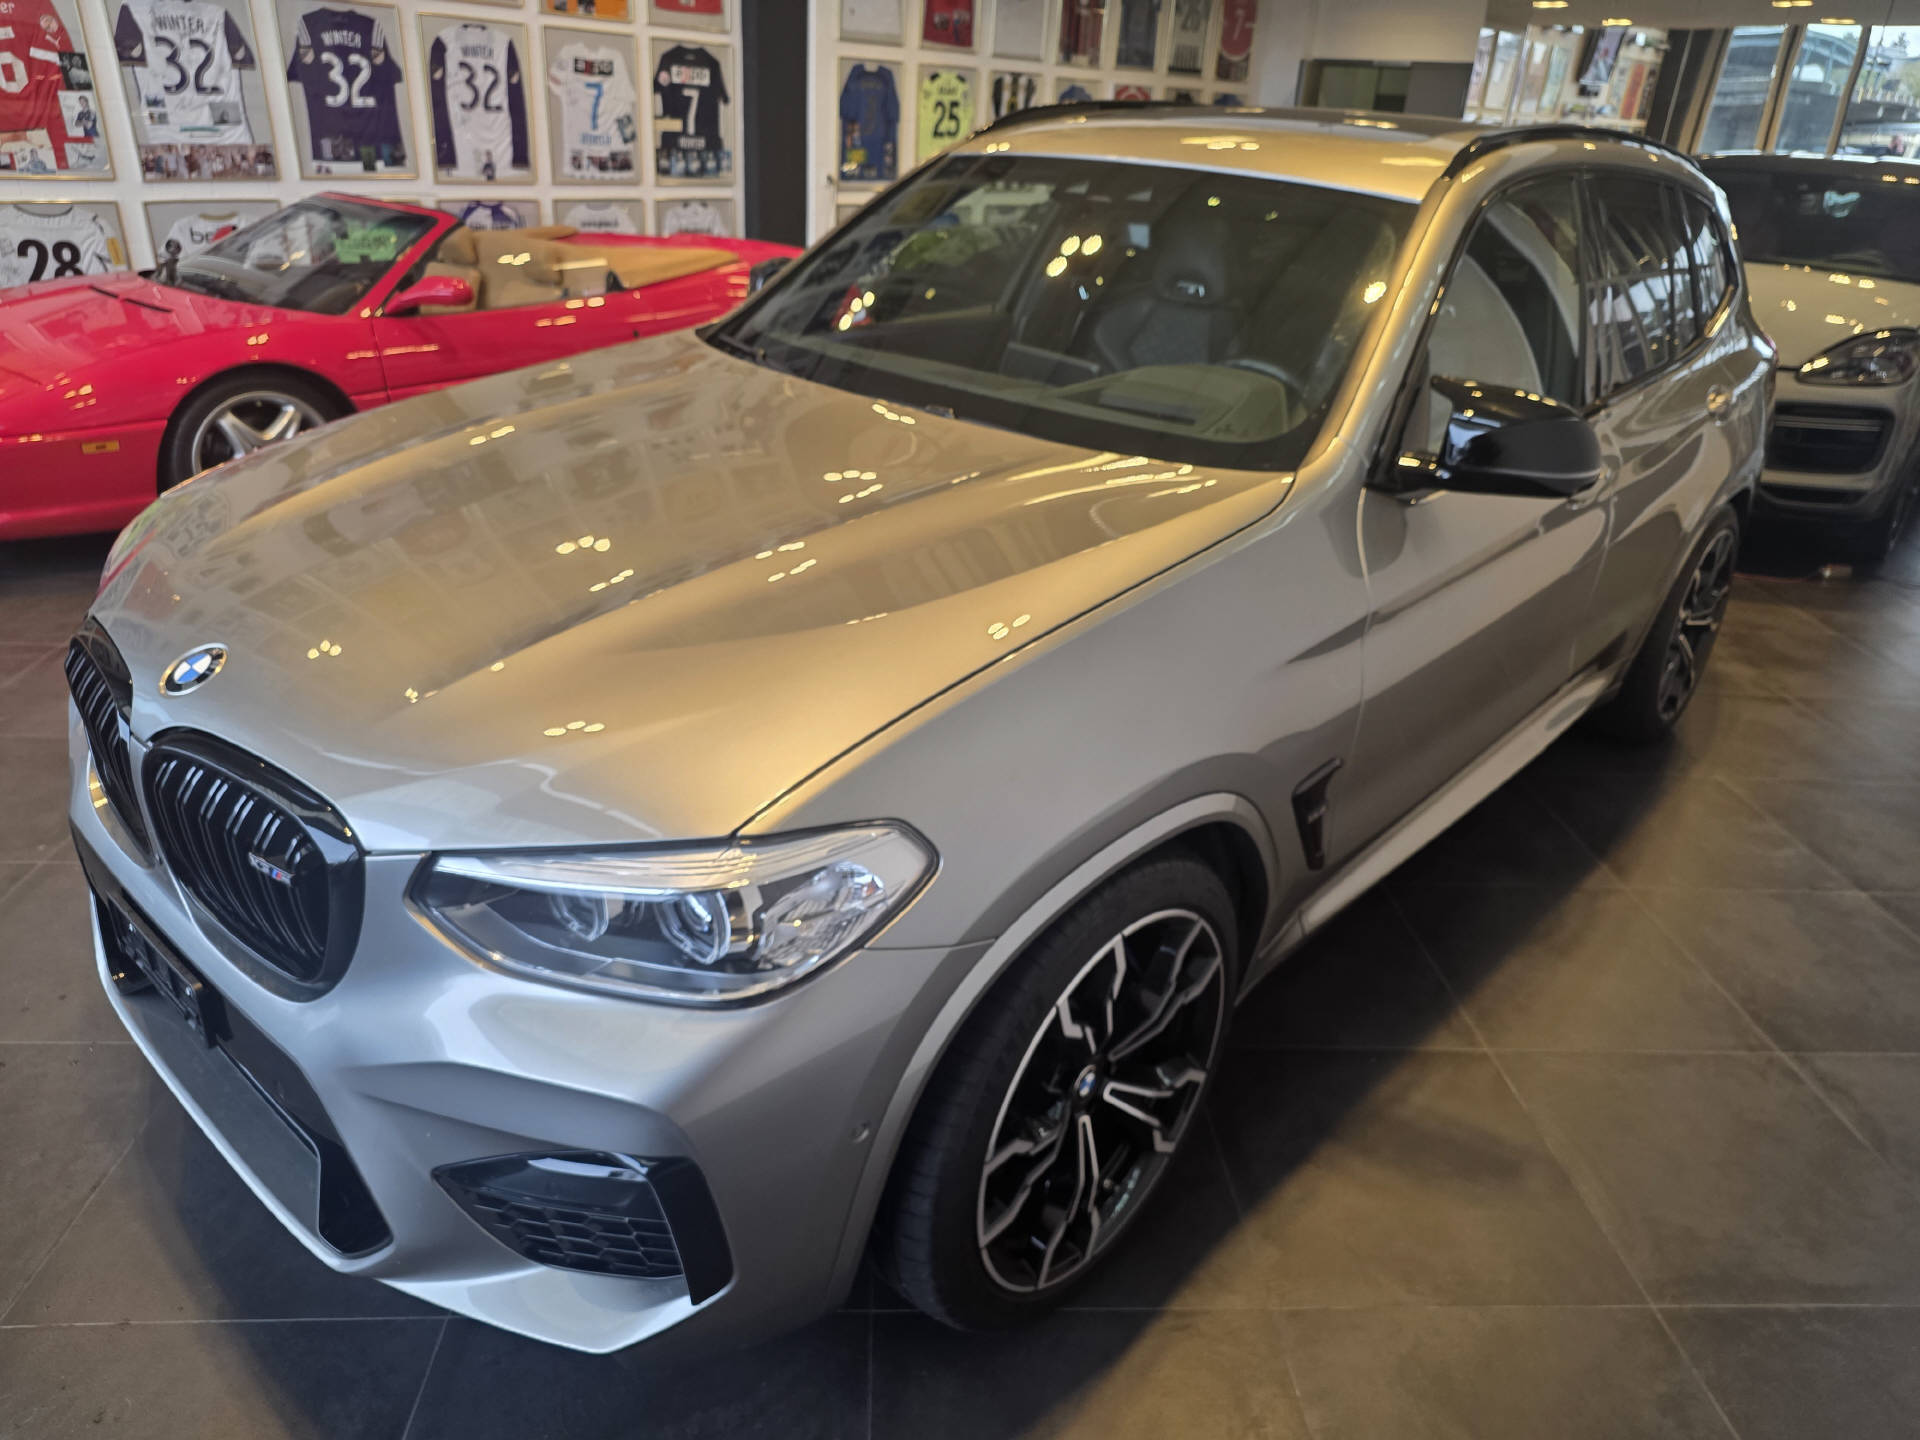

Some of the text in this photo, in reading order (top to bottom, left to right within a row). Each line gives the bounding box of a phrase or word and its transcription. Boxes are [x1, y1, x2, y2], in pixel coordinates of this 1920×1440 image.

[154, 36, 225, 96] 32
[320, 51, 377, 109] 32
[458, 61, 503, 113] 32
[584, 82, 603, 130] 7
[682, 88, 700, 136] 7
[932, 101, 960, 137] 25
[17, 239, 84, 283] 28
